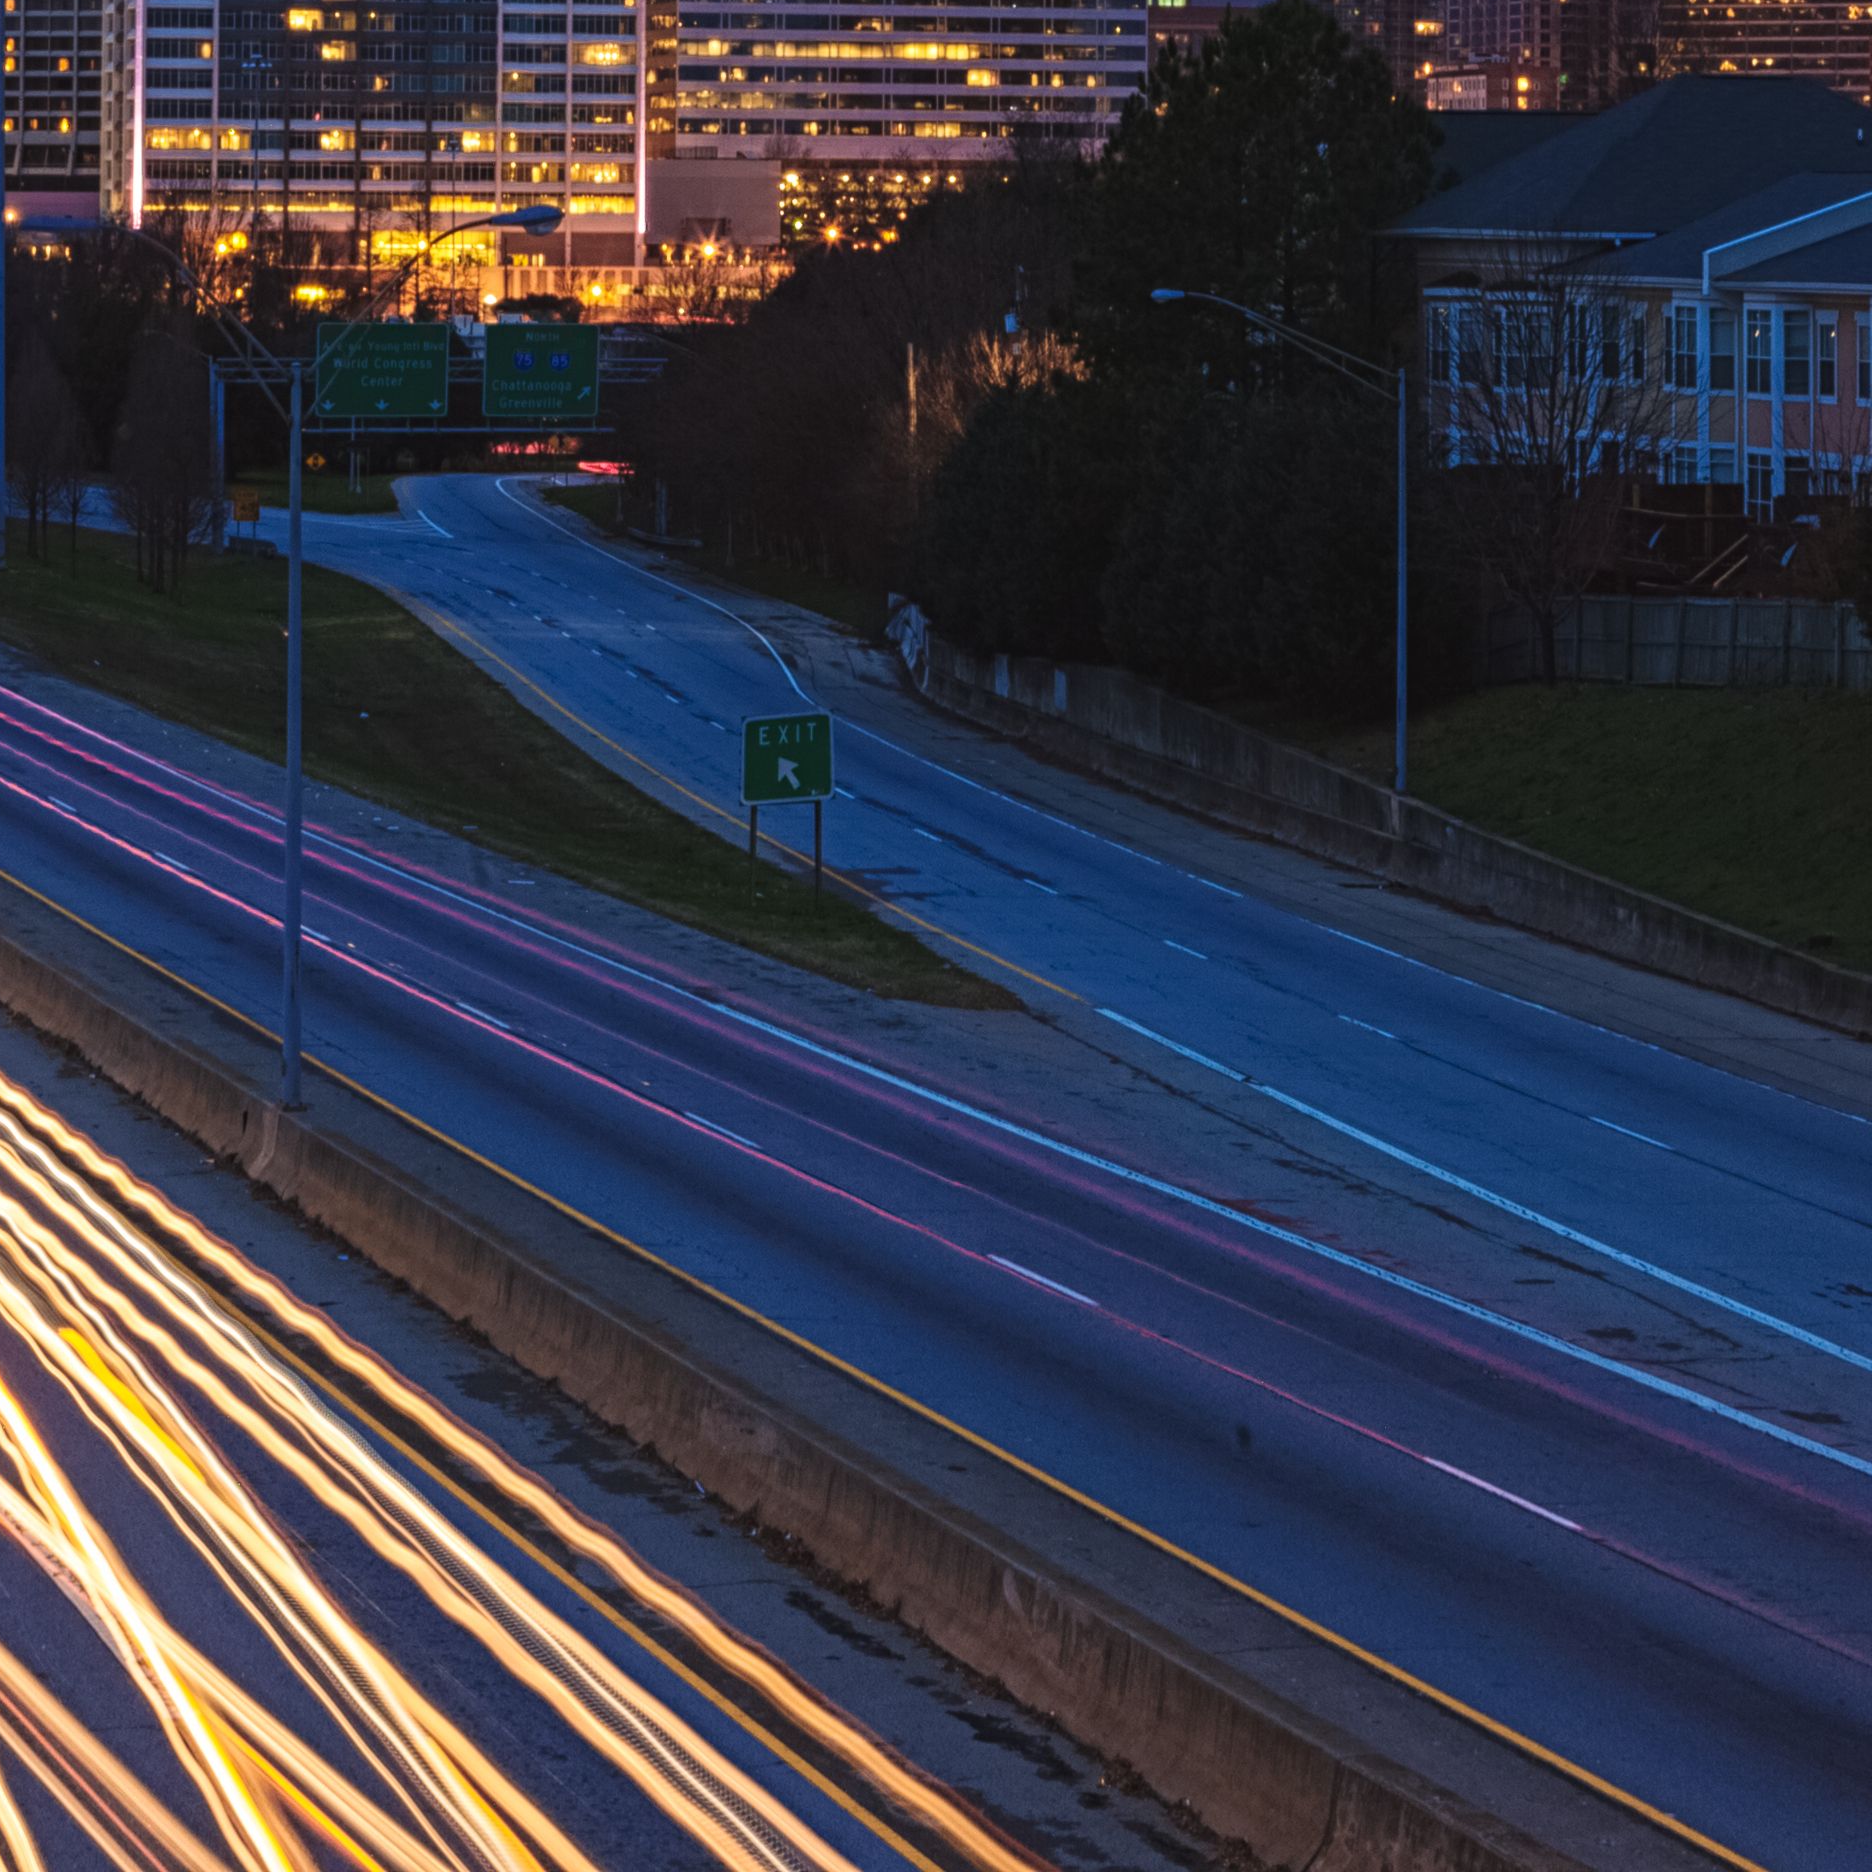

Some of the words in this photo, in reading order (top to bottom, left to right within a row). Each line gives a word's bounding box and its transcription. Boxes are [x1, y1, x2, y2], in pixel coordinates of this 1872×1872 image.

[526, 332, 559, 342] NORTH
[367, 340, 401, 354] Young
[332, 357, 369, 369] World
[374, 357, 433, 373] Congress
[515, 352, 533, 367] 75
[551, 353, 568, 368] 85
[361, 375, 404, 387] Center
[492, 379, 573, 393] Chattanooga
[498, 396, 563, 409] Greenville
[758, 722, 817, 746] EXIT
